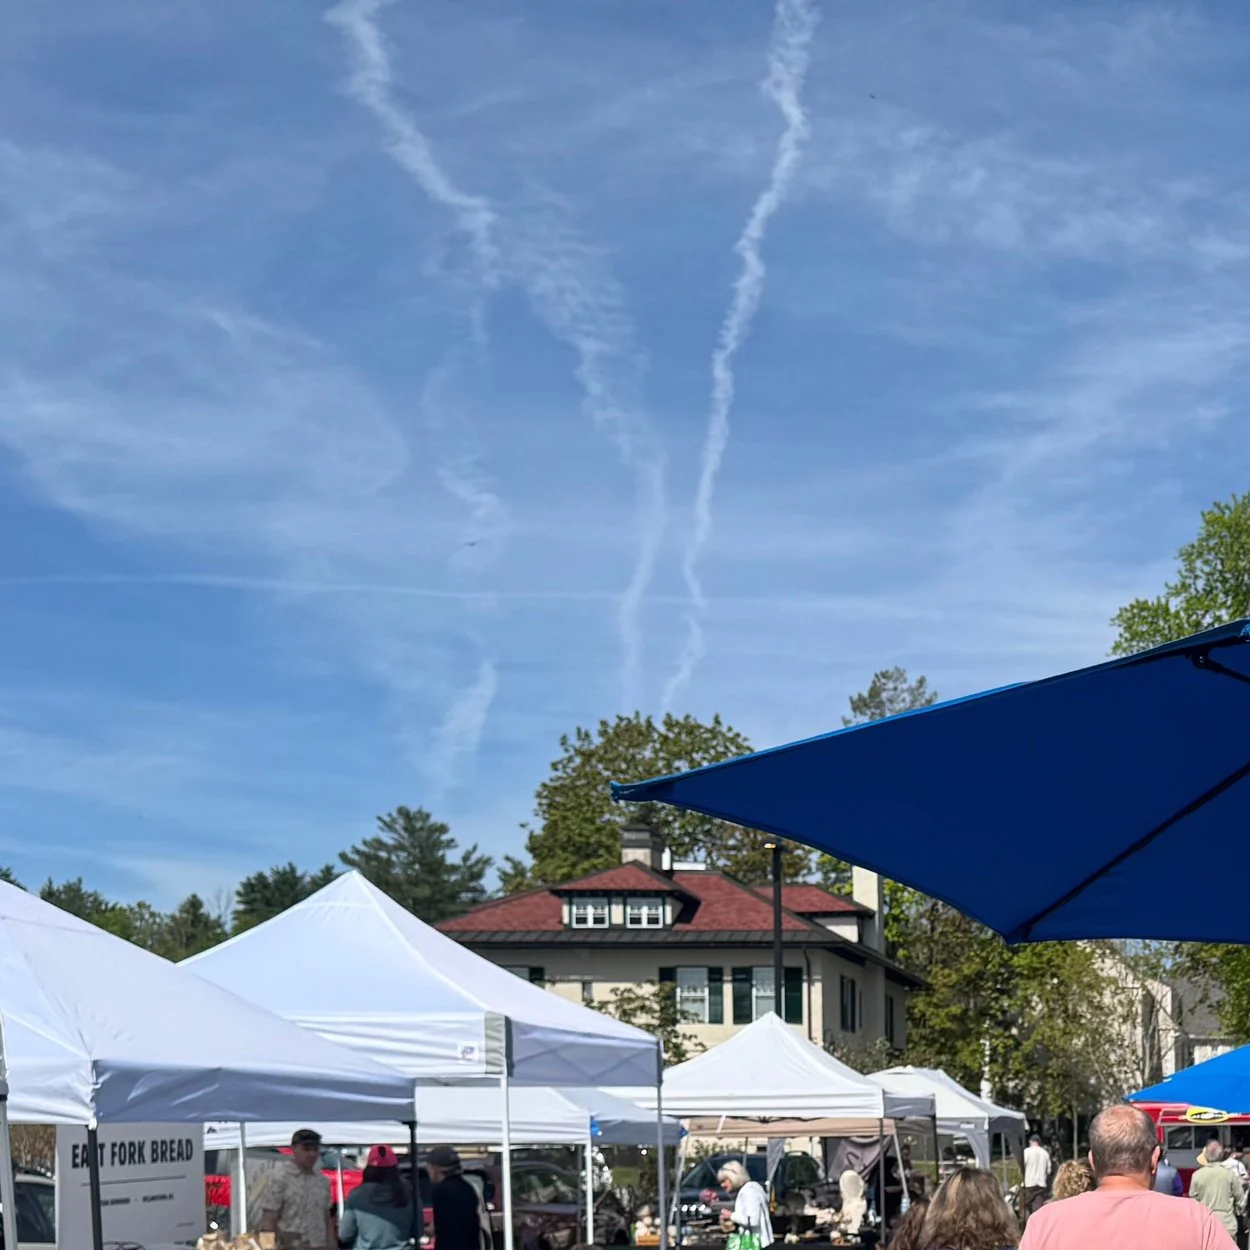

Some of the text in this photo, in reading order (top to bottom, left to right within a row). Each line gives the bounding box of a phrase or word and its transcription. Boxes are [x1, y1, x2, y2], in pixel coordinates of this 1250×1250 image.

[72, 1138, 193, 1168] EAT FORK BREAD
